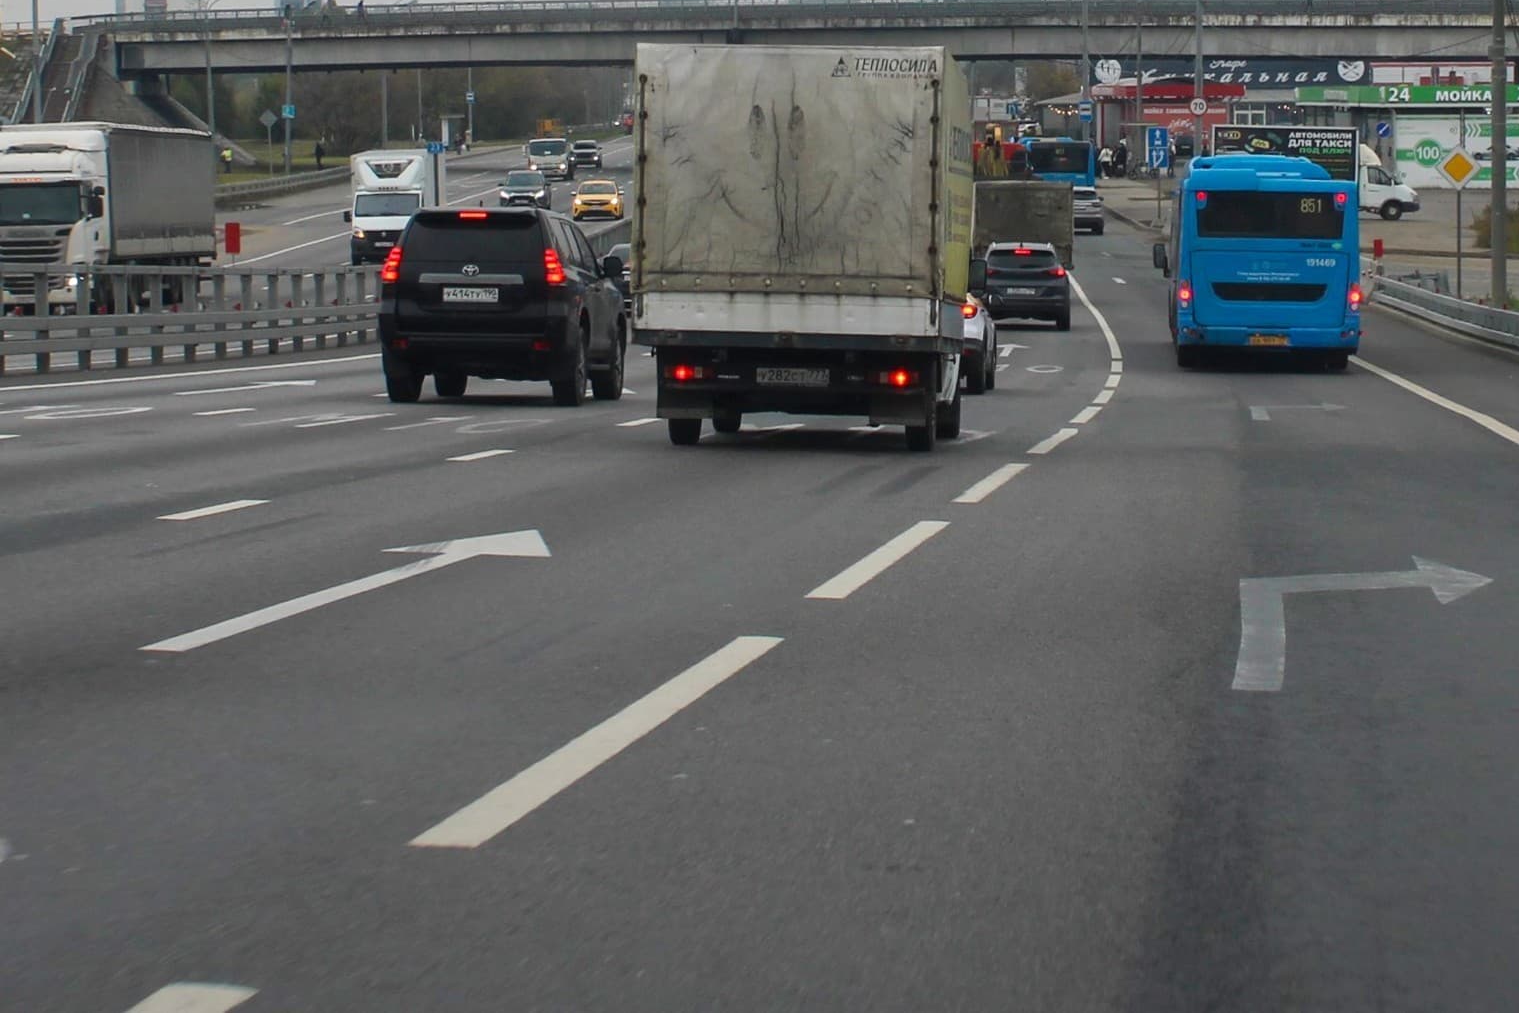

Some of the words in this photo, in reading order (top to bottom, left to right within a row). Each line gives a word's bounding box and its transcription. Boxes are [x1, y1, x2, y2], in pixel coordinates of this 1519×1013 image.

[855, 57, 937, 72] ТЕПЛОСИЛА
[1435, 86, 1493, 101] МОЙКА
[1193, 101, 1205, 111] 70
[1288, 131, 1352, 140] АВТОМОБИЛИ
[1288, 139, 1312, 148] ДЛЯ
[1315, 139, 1352, 147] ТАКСИ
[1300, 147, 1320, 155] ПОД
[1416, 146, 1439, 160] 100
[1300, 198, 1321, 213] 851
